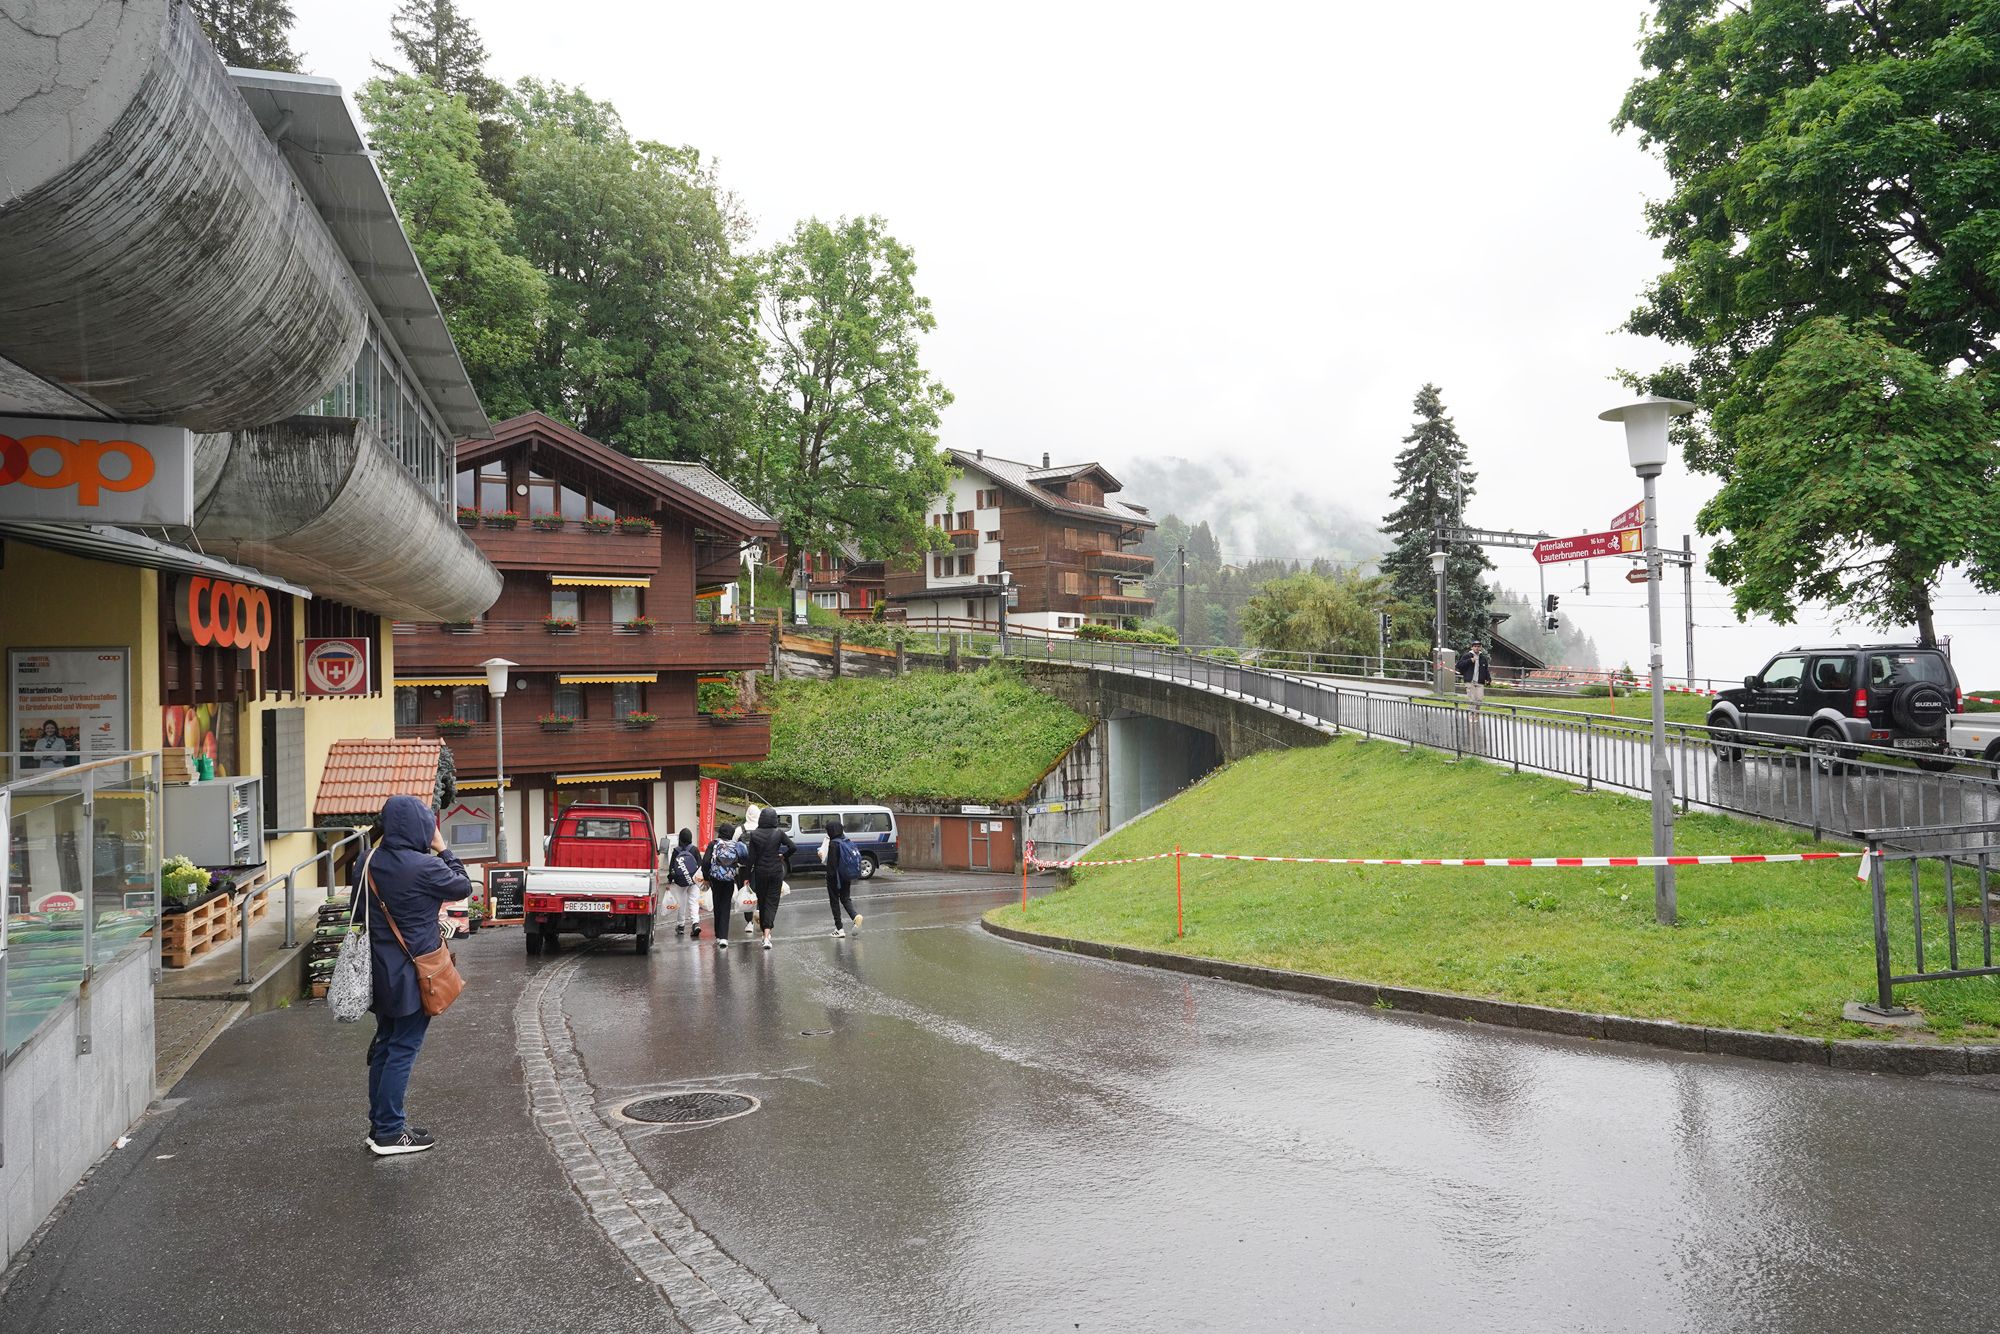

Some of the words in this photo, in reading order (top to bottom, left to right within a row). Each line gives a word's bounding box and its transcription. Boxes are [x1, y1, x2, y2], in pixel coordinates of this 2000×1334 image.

[1540, 541, 1573, 552] Interlaken
[1540, 549, 1589, 562] Lauterbrunnen
[188, 575, 272, 670] coop
